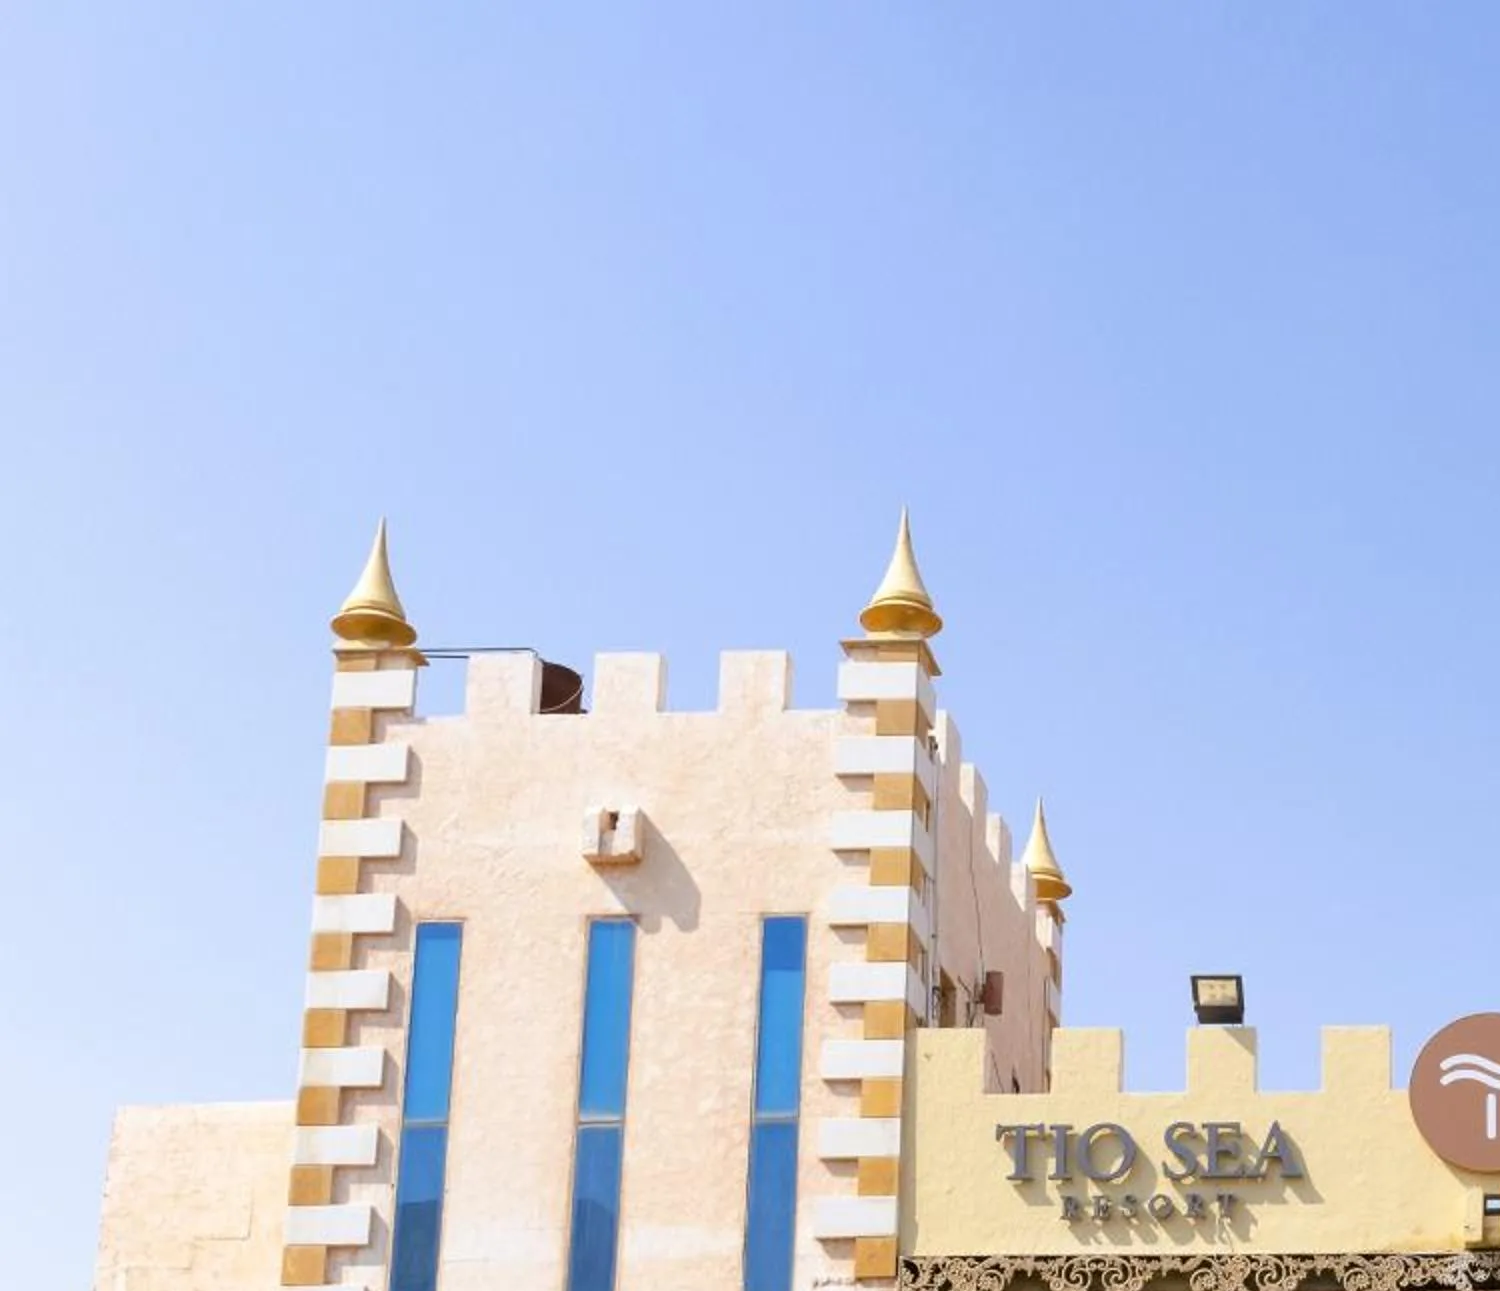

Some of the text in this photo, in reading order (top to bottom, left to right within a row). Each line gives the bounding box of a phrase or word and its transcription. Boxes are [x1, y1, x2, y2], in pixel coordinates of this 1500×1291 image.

[995, 1120, 1305, 1183] TIO SEA
[1060, 1193, 1237, 1221] RESORT
